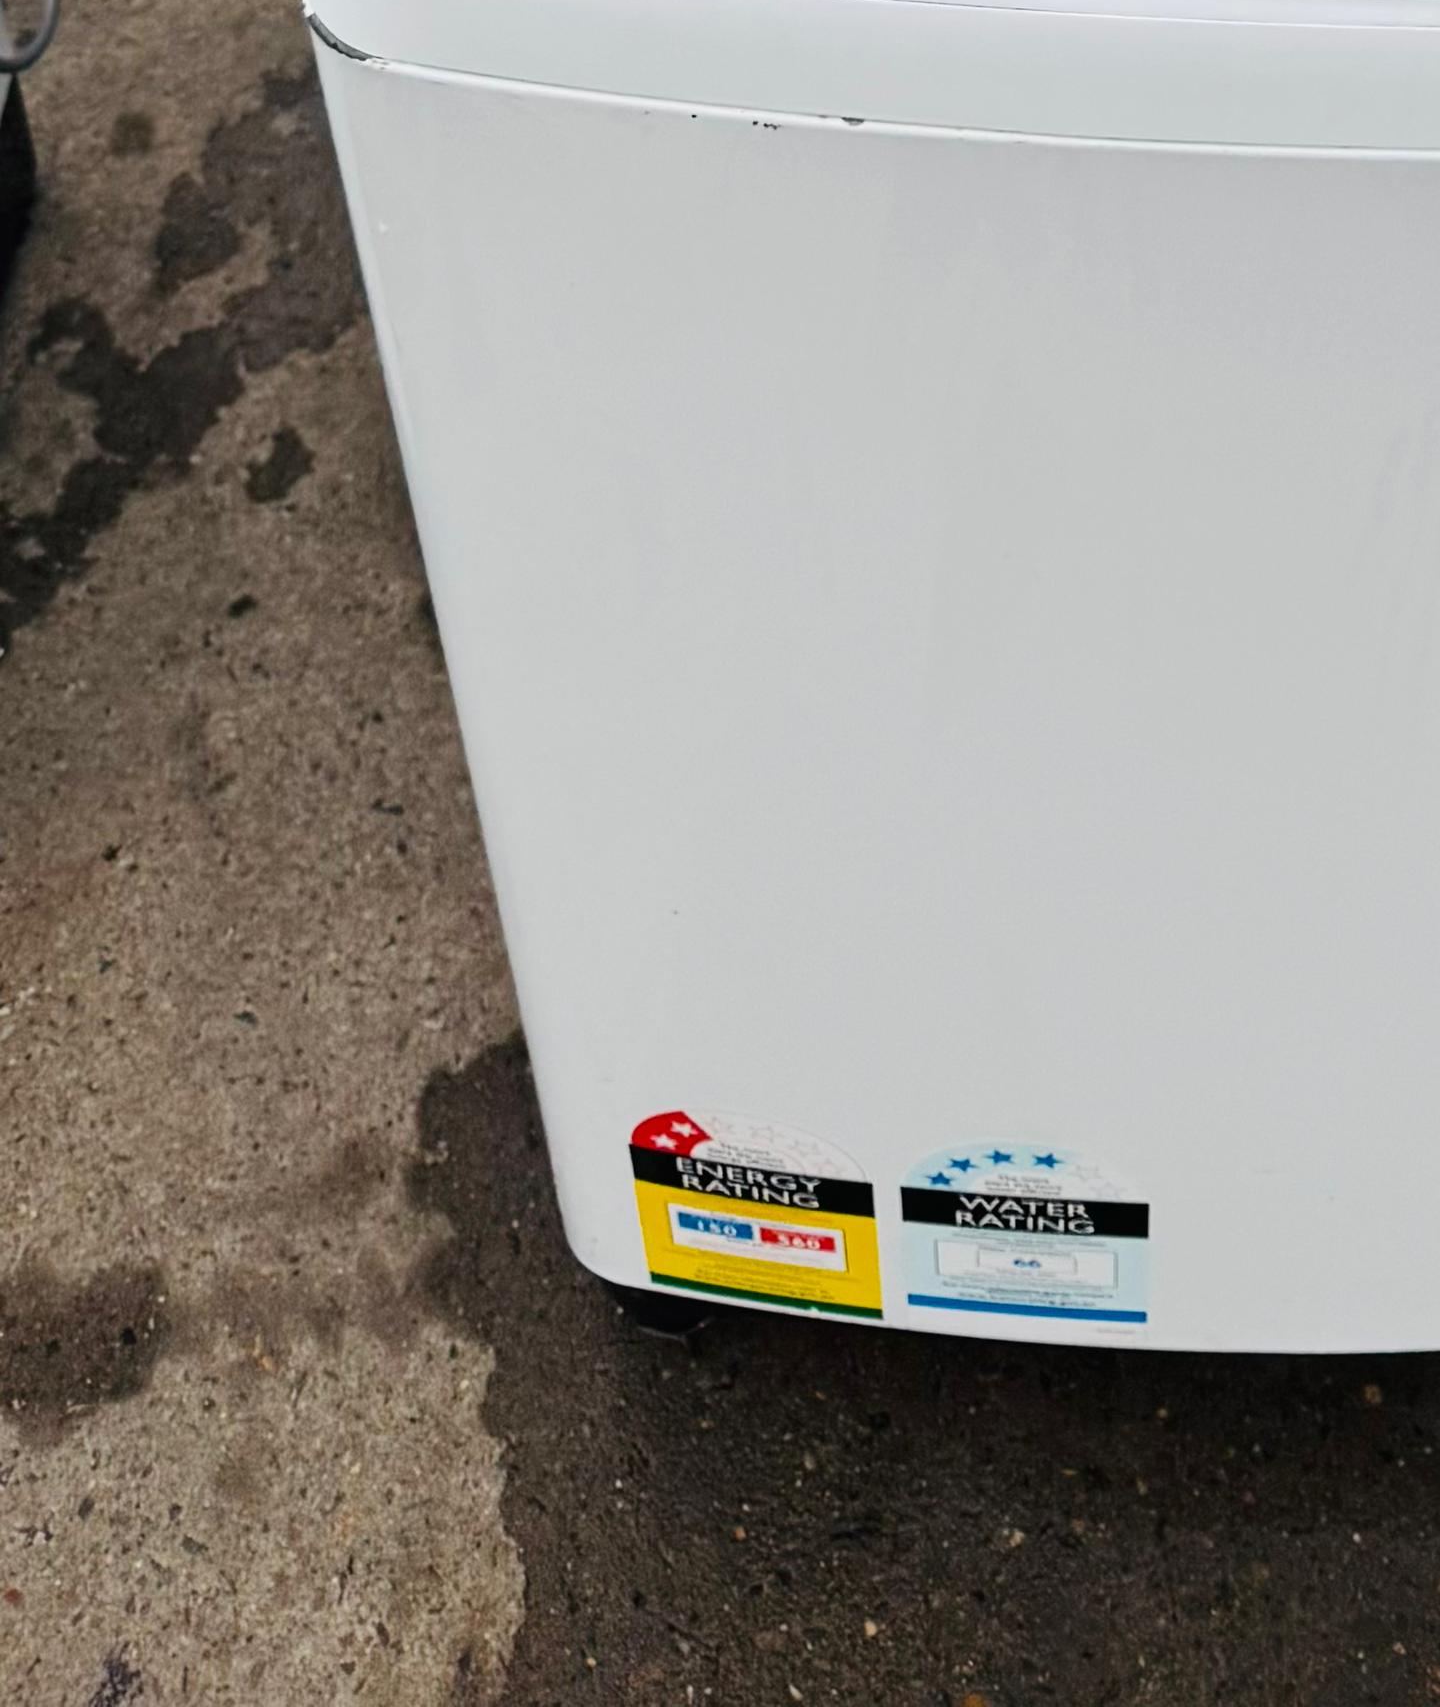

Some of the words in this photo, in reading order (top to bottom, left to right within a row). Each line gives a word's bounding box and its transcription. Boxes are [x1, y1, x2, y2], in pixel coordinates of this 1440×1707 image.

[675, 1156, 821, 1194] ENERGY
[681, 1174, 821, 1210] RATING
[959, 1194, 1089, 1218] WATER
[955, 1209, 1095, 1235] RATING
